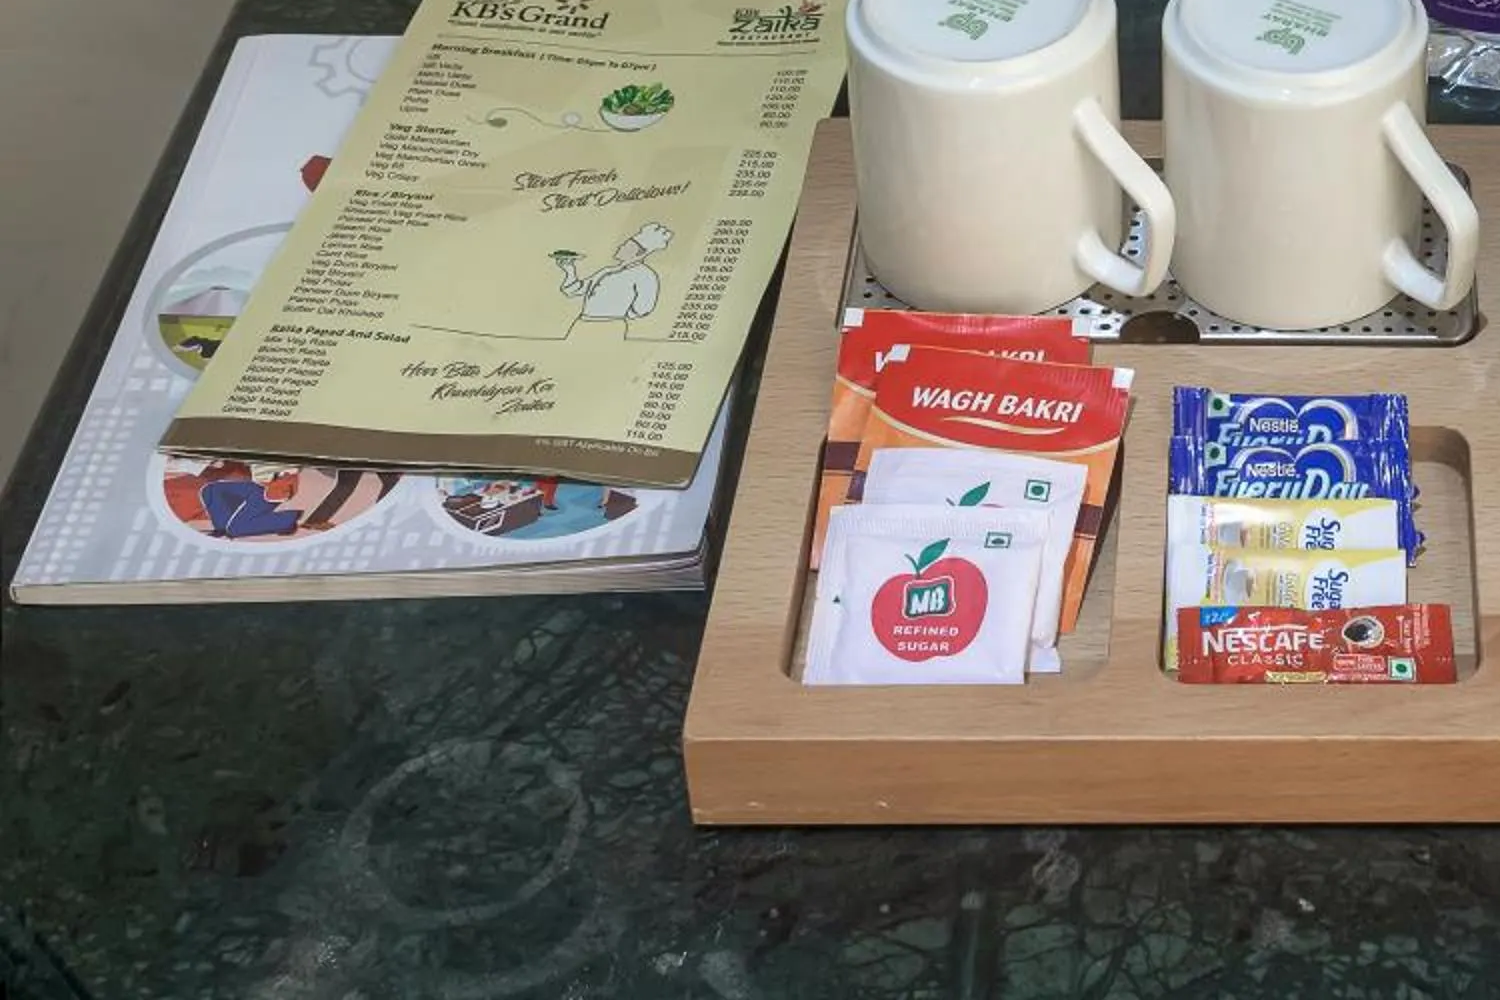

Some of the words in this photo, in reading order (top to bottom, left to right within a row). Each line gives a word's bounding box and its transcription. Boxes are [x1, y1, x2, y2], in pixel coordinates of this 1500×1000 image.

[375, 331, 410, 343] Salad
[911, 386, 994, 412] WAGH
[998, 394, 1084, 423] BAKRI
[1327, 568, 1349, 609] Suga
[910, 586, 945, 615] MB
[893, 626, 959, 636] REFINED
[897, 641, 950, 652] SUGAR
[1227, 653, 1304, 666] CLASSIC
